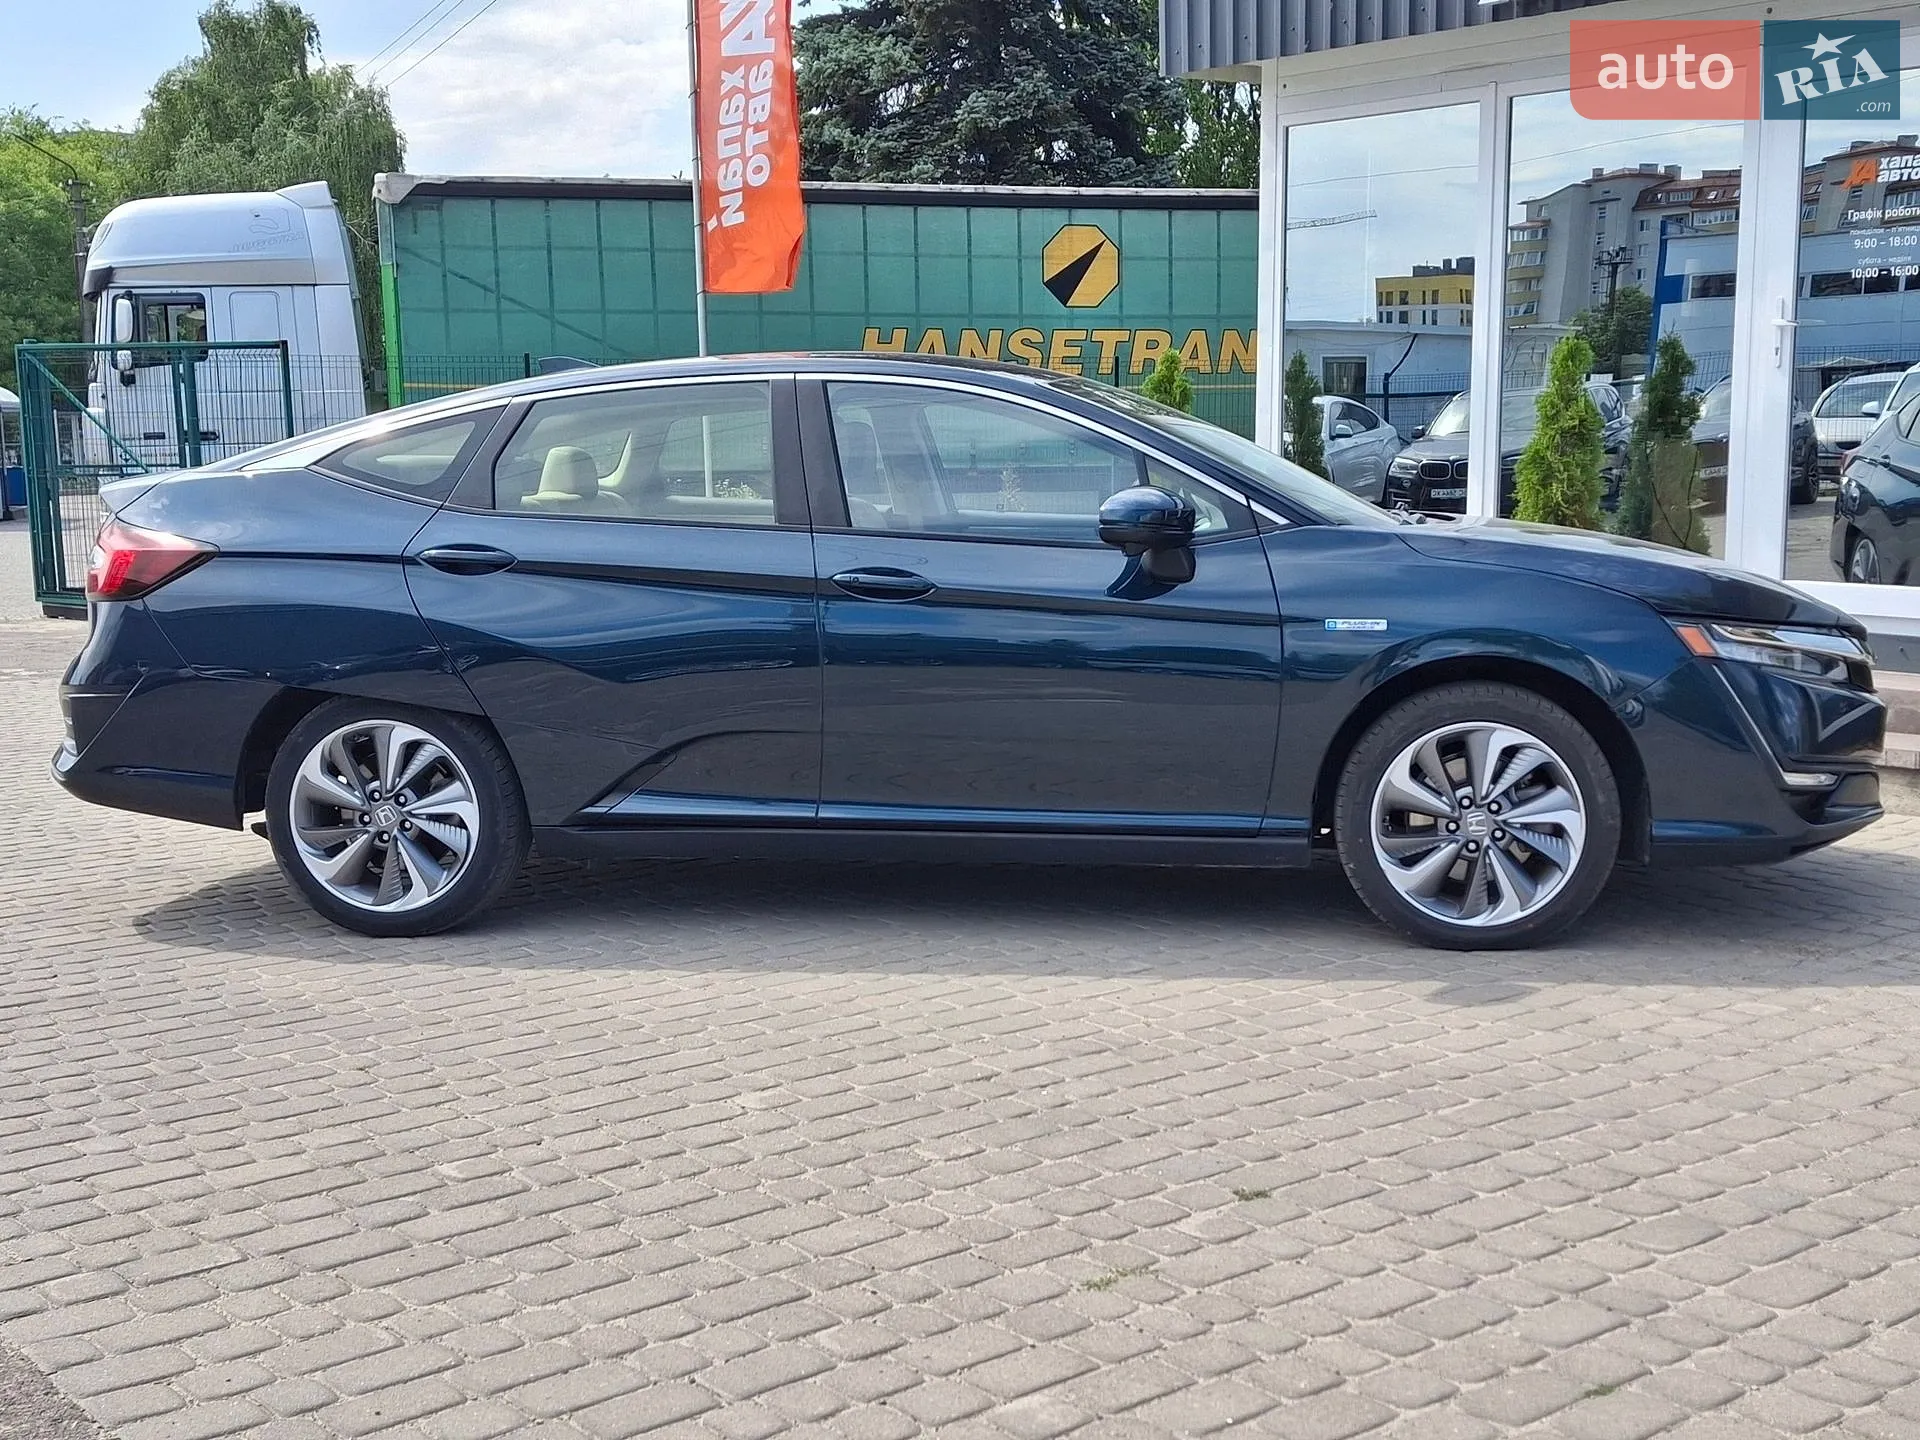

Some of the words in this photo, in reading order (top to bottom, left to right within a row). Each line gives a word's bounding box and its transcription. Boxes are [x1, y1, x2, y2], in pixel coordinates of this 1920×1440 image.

[1877, 167, 1920, 183] авто
[1848, 208, 1883, 222] Графік
[1854, 238, 1877, 249] 9:00
[1888, 234, 1918, 247] 18:00
[1851, 267, 1879, 279] 10:00
[1890, 264, 1919, 277] 16:00
[861, 327, 1258, 375] HANSETRAN
